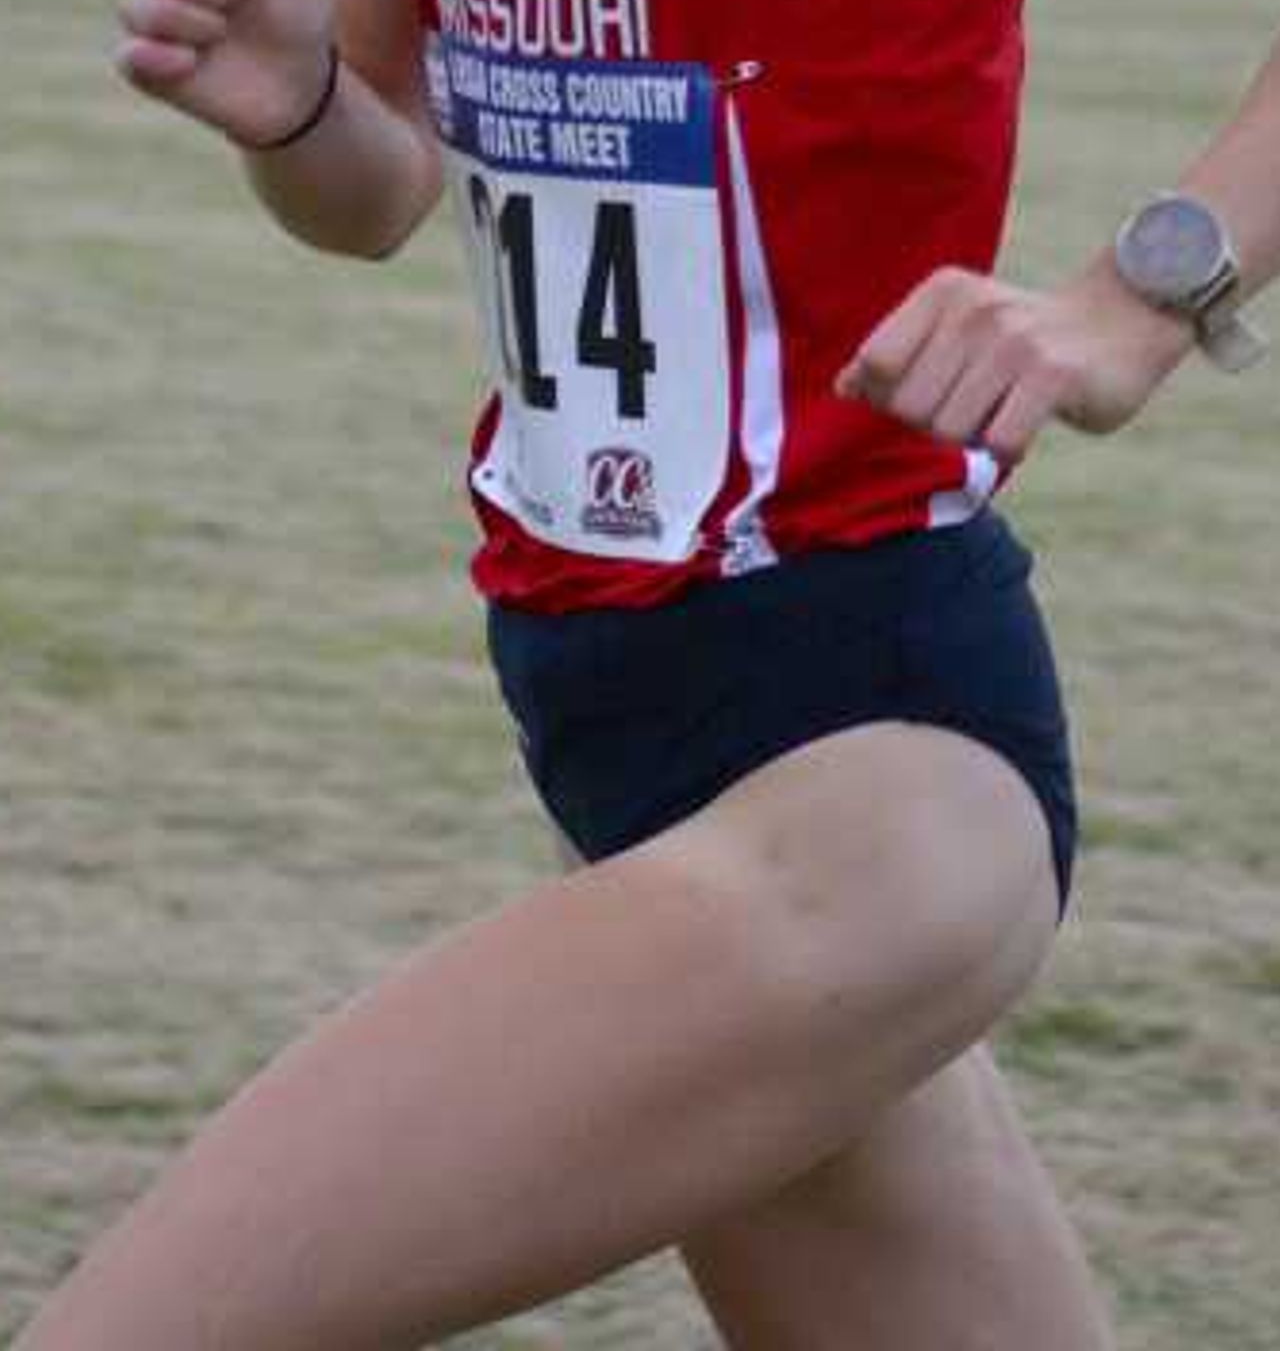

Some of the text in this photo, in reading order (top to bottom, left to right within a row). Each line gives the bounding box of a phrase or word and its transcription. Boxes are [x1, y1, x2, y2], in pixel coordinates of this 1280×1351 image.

[490, 63, 560, 114] CROSS
[566, 73, 688, 123] COUNTRY
[549, 121, 631, 167] MEET
